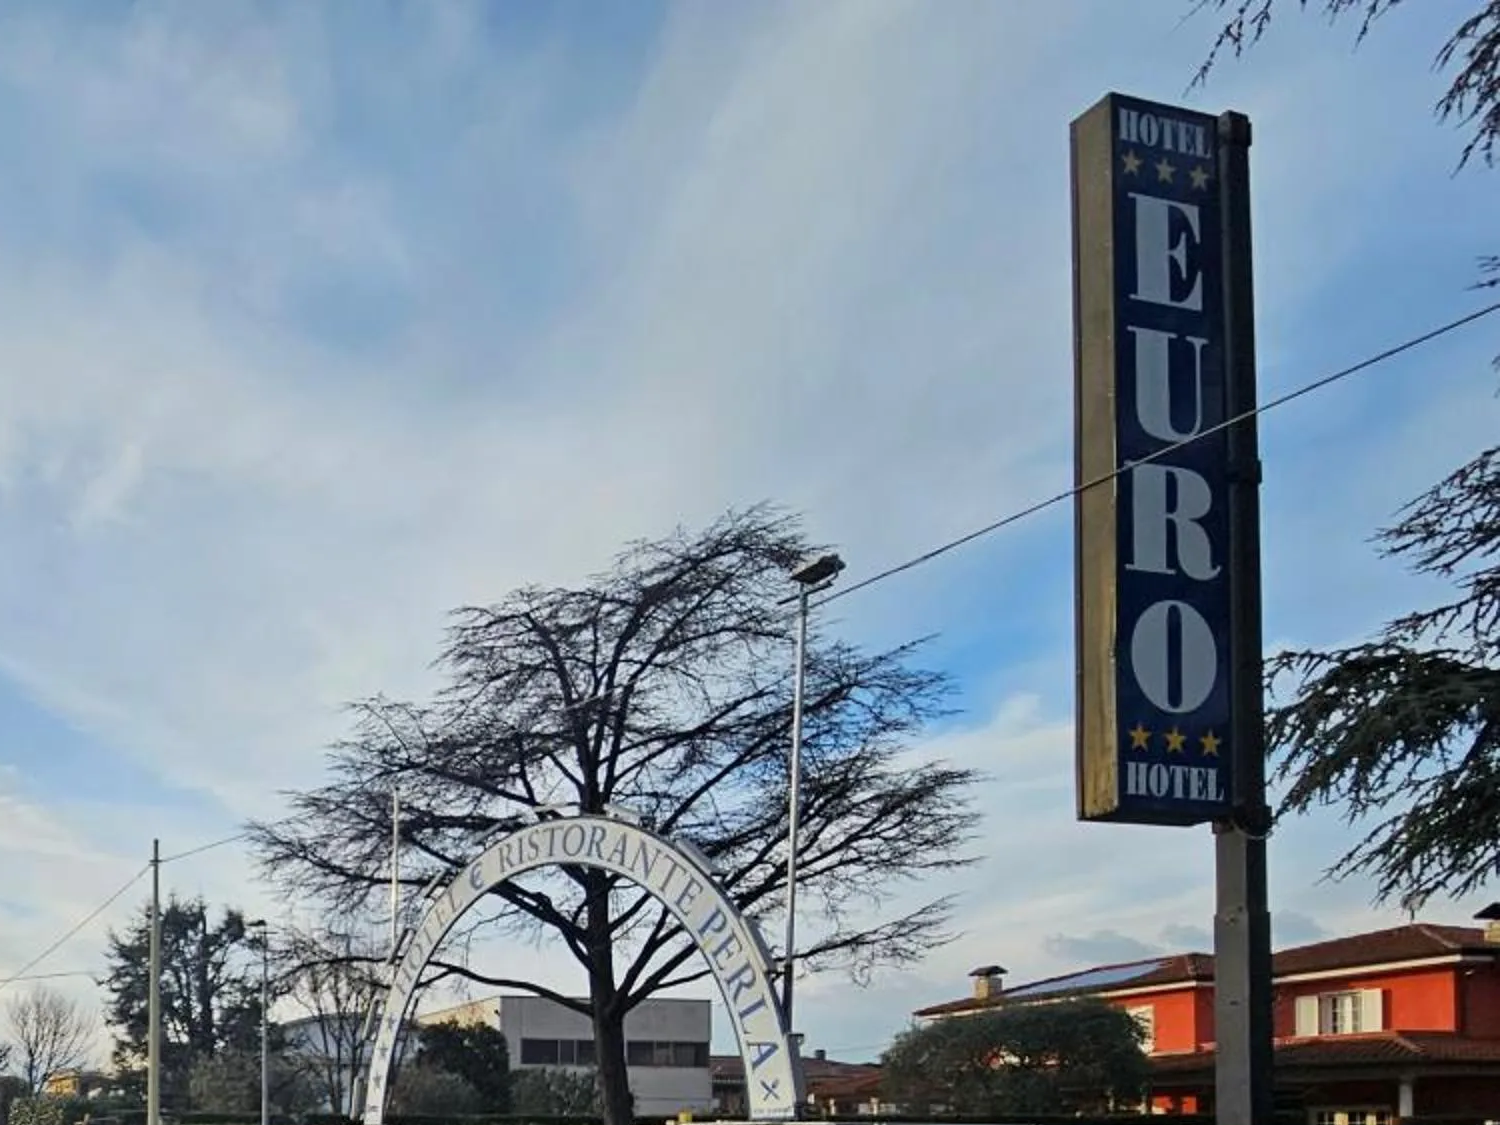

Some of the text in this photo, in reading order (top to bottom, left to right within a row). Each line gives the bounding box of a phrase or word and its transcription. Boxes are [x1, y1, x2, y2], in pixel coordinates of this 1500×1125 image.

[1119, 106, 1212, 159] HOTEL
[1125, 192, 1221, 714] EURO
[1125, 761, 1224, 802] HOTEL
[395, 888, 463, 995] HOTEL
[498, 823, 704, 917] RISTORANTE
[698, 908, 779, 1068] PERLA
